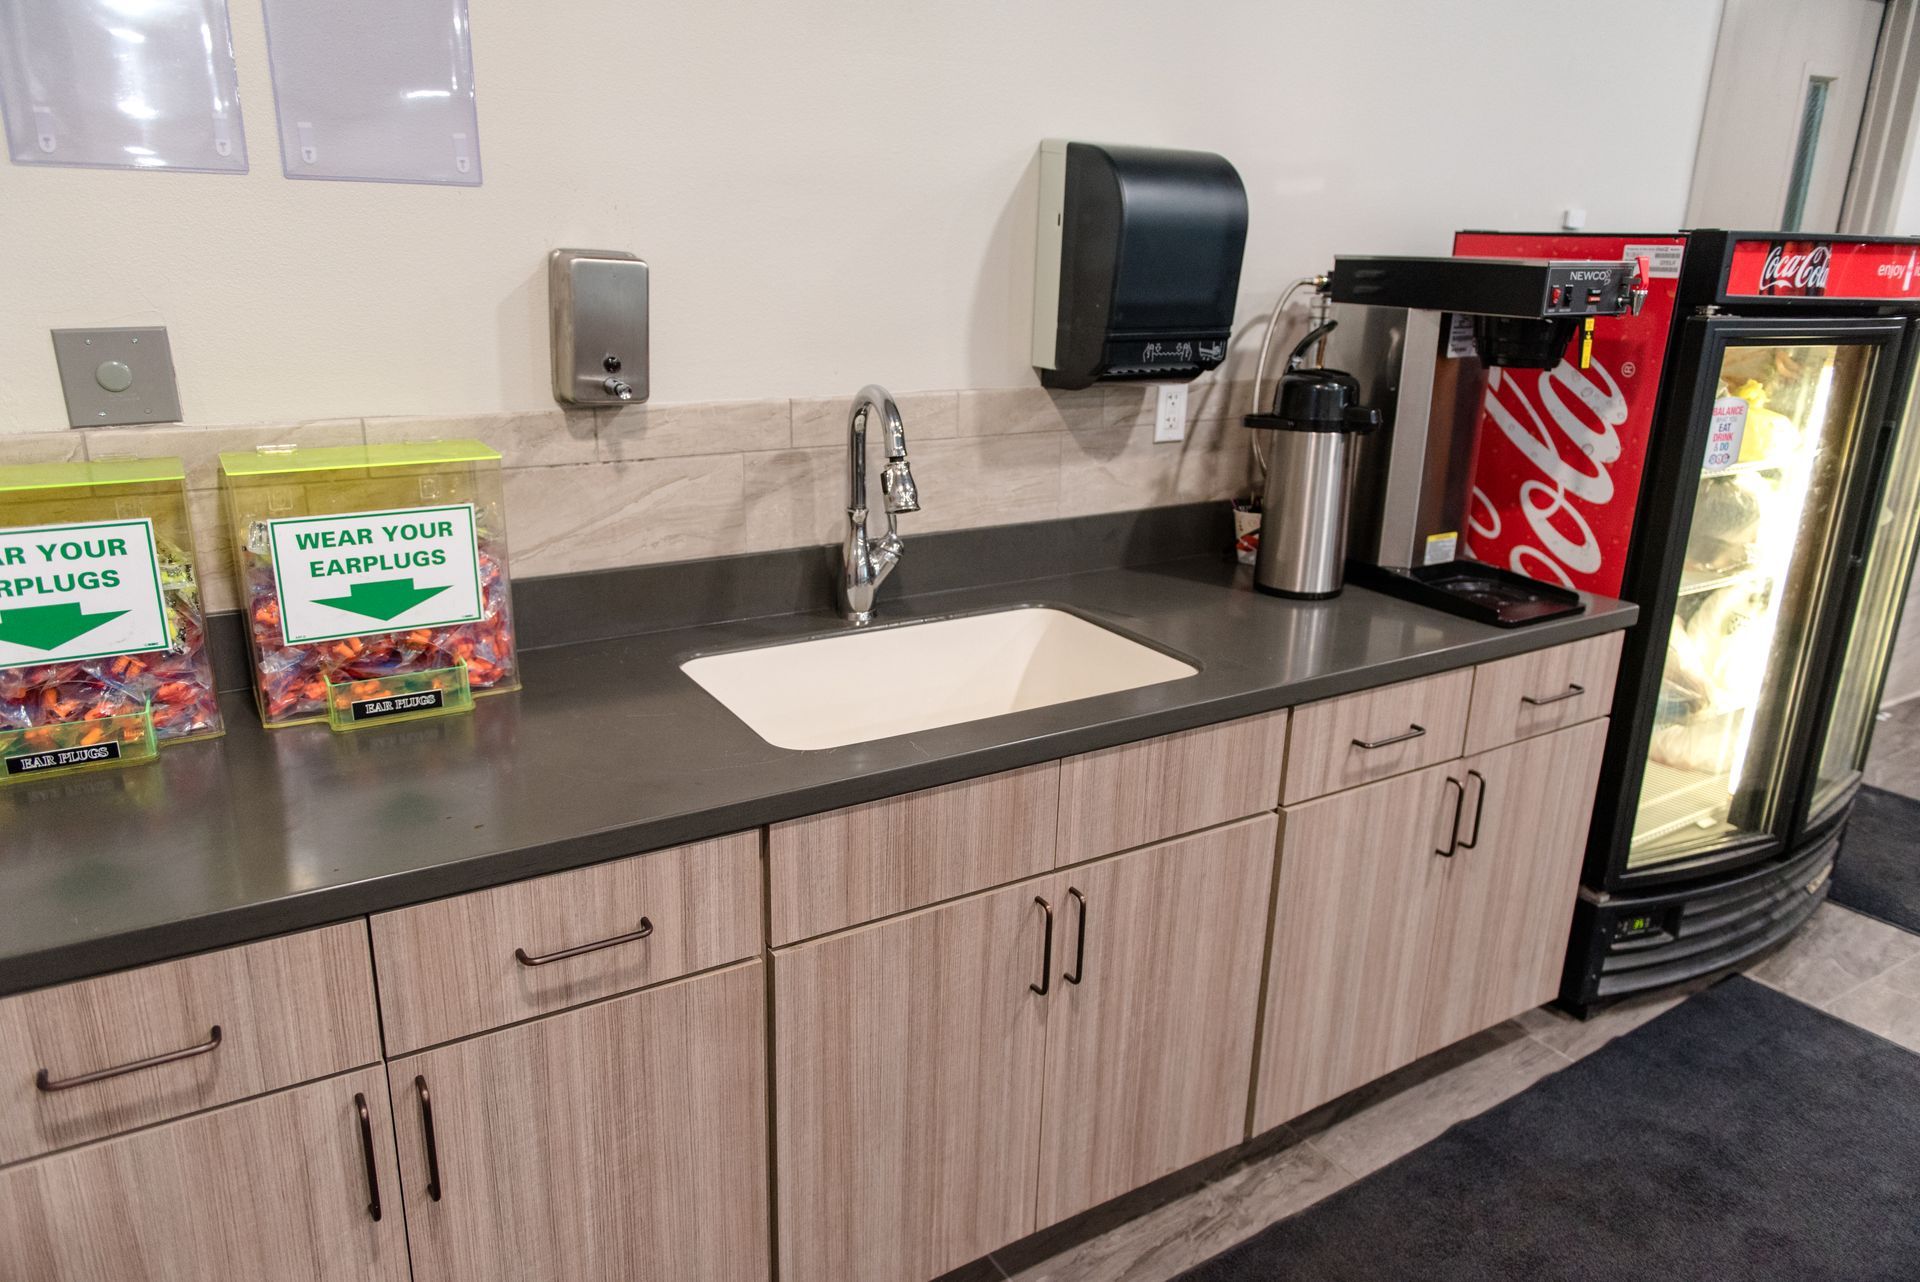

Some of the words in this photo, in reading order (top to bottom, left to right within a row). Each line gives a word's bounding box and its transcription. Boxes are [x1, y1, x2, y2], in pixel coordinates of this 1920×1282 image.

[1569, 270, 1606, 281] NEWCO
[1878, 262, 1905, 279] enjoy
[1713, 405, 1744, 416] BALANCE
[1719, 422, 1731, 432] EAT
[1713, 432, 1733, 443] DRINK
[295, 528, 374, 551] WEAR
[382, 521, 454, 543] YOUR
[35, 538, 128, 562] YOUR
[309, 549, 447, 578] EARPLUGS
[365, 702, 394, 714] EAR
[395, 694, 436, 709] PLUGS
[20, 755, 57, 770] EAR
[58, 746, 109, 764] PLUGS
